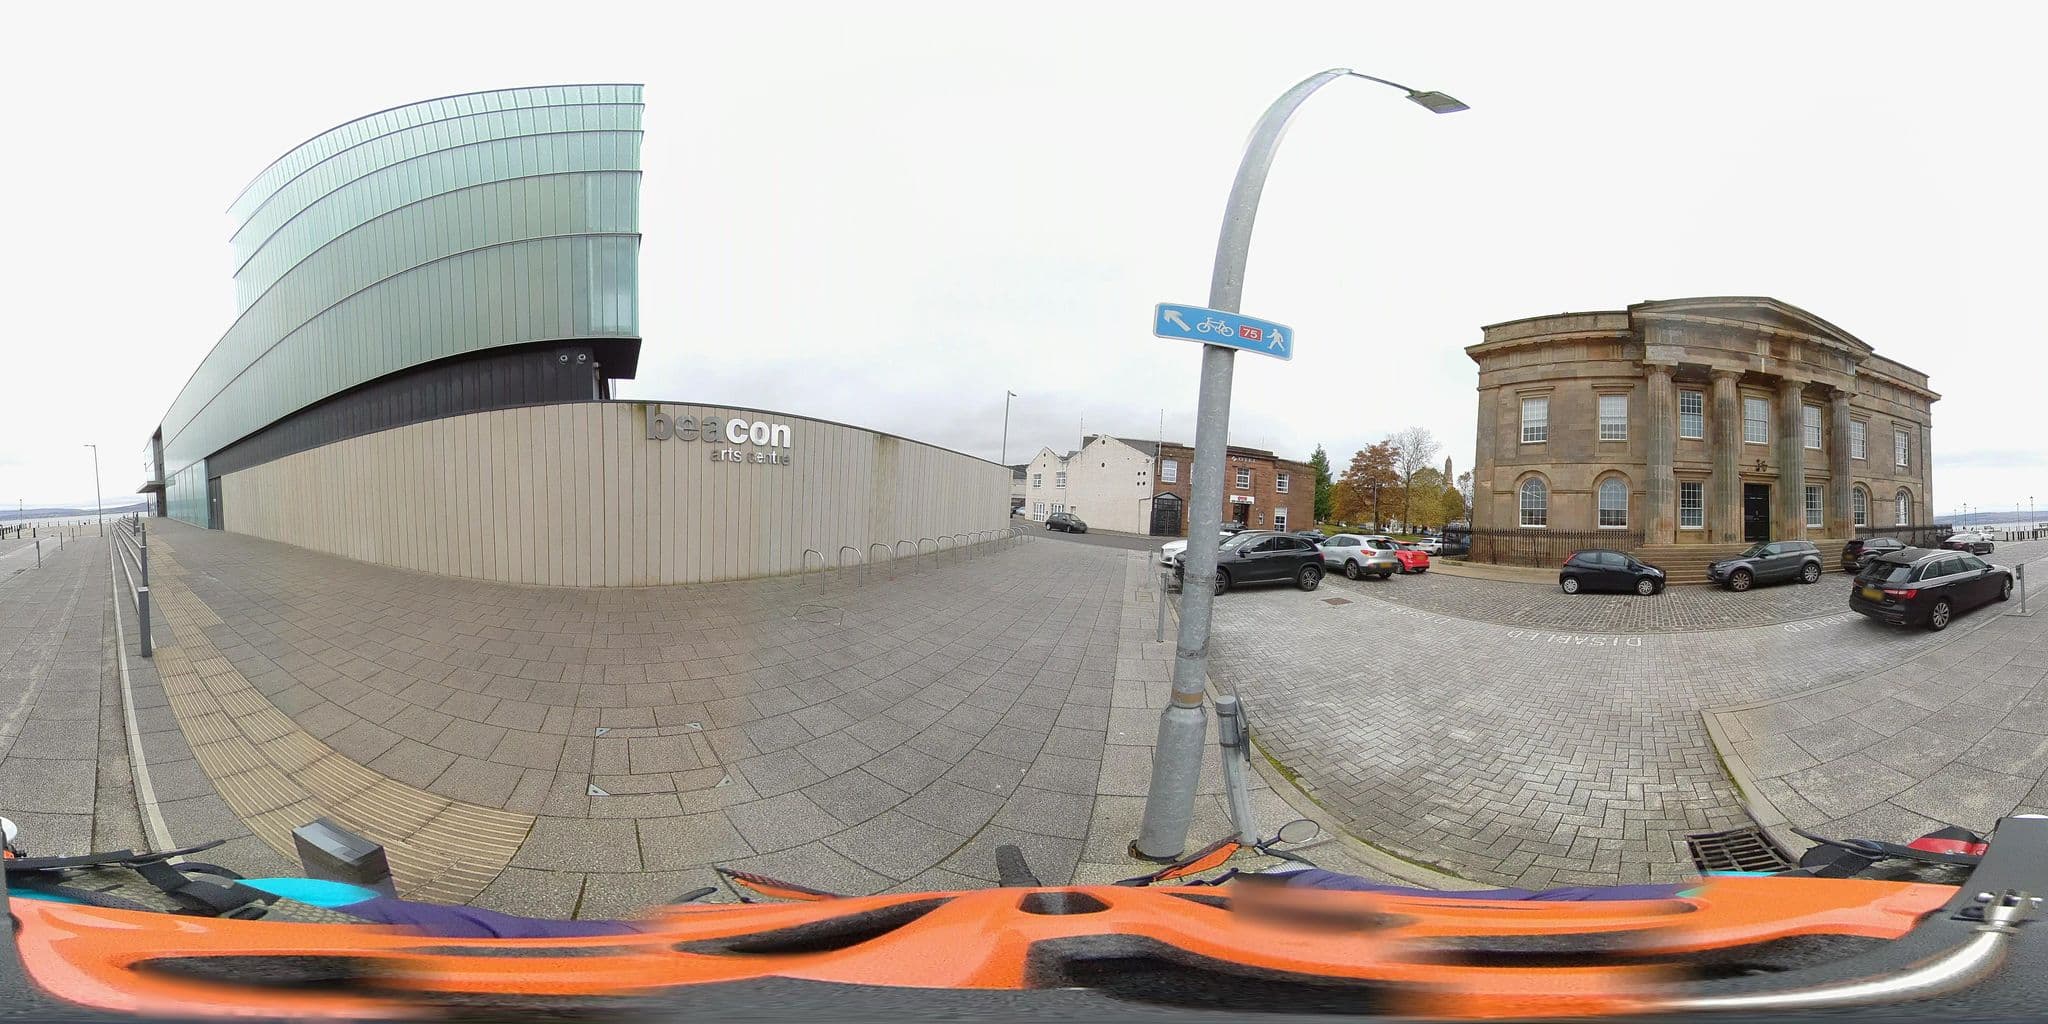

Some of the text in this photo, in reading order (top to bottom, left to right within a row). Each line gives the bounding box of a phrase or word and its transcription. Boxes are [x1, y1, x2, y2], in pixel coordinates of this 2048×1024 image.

[1243, 328, 1258, 339] 75
[645, 403, 791, 448] beacon
[711, 447, 790, 466] arts centre
[1507, 630, 1642, 647] DISABLED
